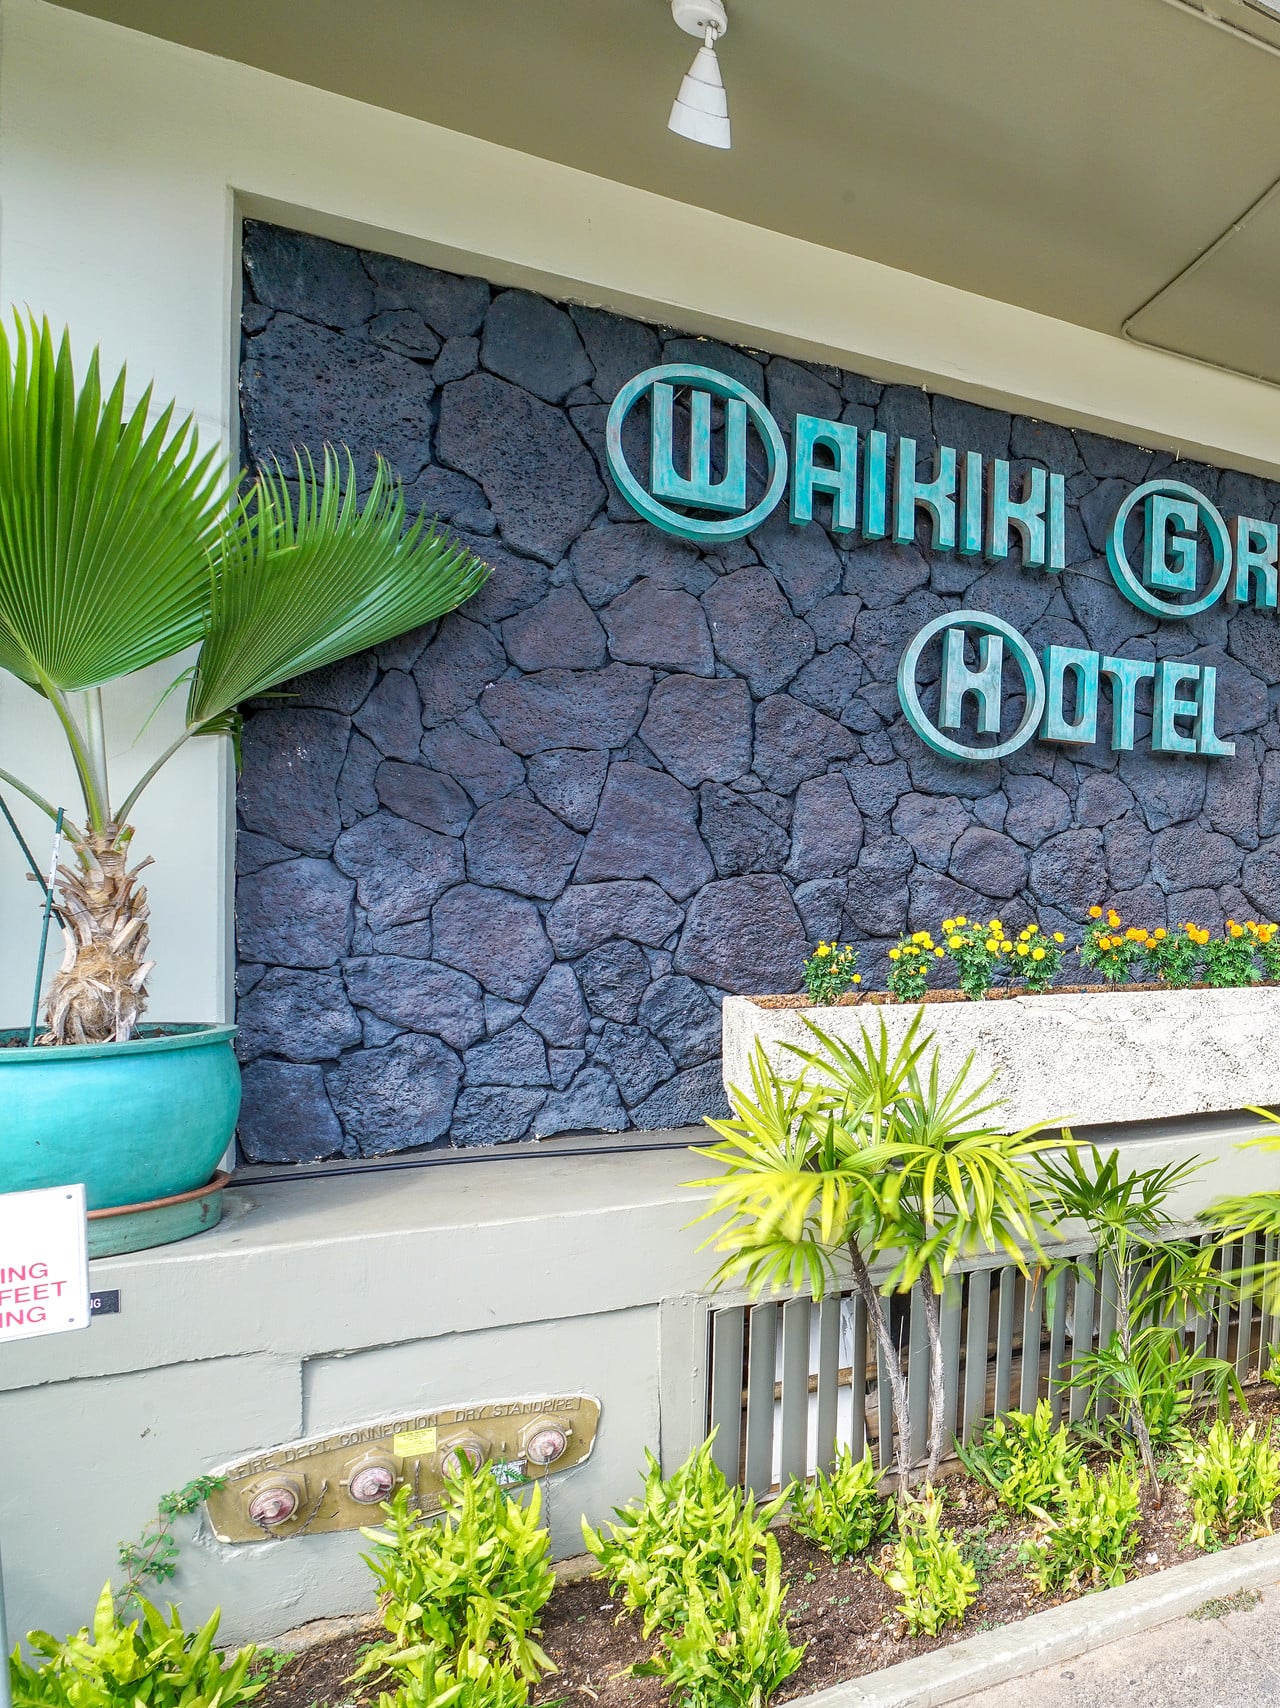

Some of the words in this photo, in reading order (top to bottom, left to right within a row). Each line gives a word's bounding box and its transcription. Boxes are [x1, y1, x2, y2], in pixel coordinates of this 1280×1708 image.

[651, 382, 1065, 574] WAIKIKI
[938, 628, 1235, 758] HOTEL
[0, 1280, 67, 1306] FEET
[235, 1453, 279, 1478] FIRE
[339, 1414, 438, 1447] CONNECTION
[455, 1407, 486, 1423] DRY
[493, 1398, 575, 1417] STANDPIPE
